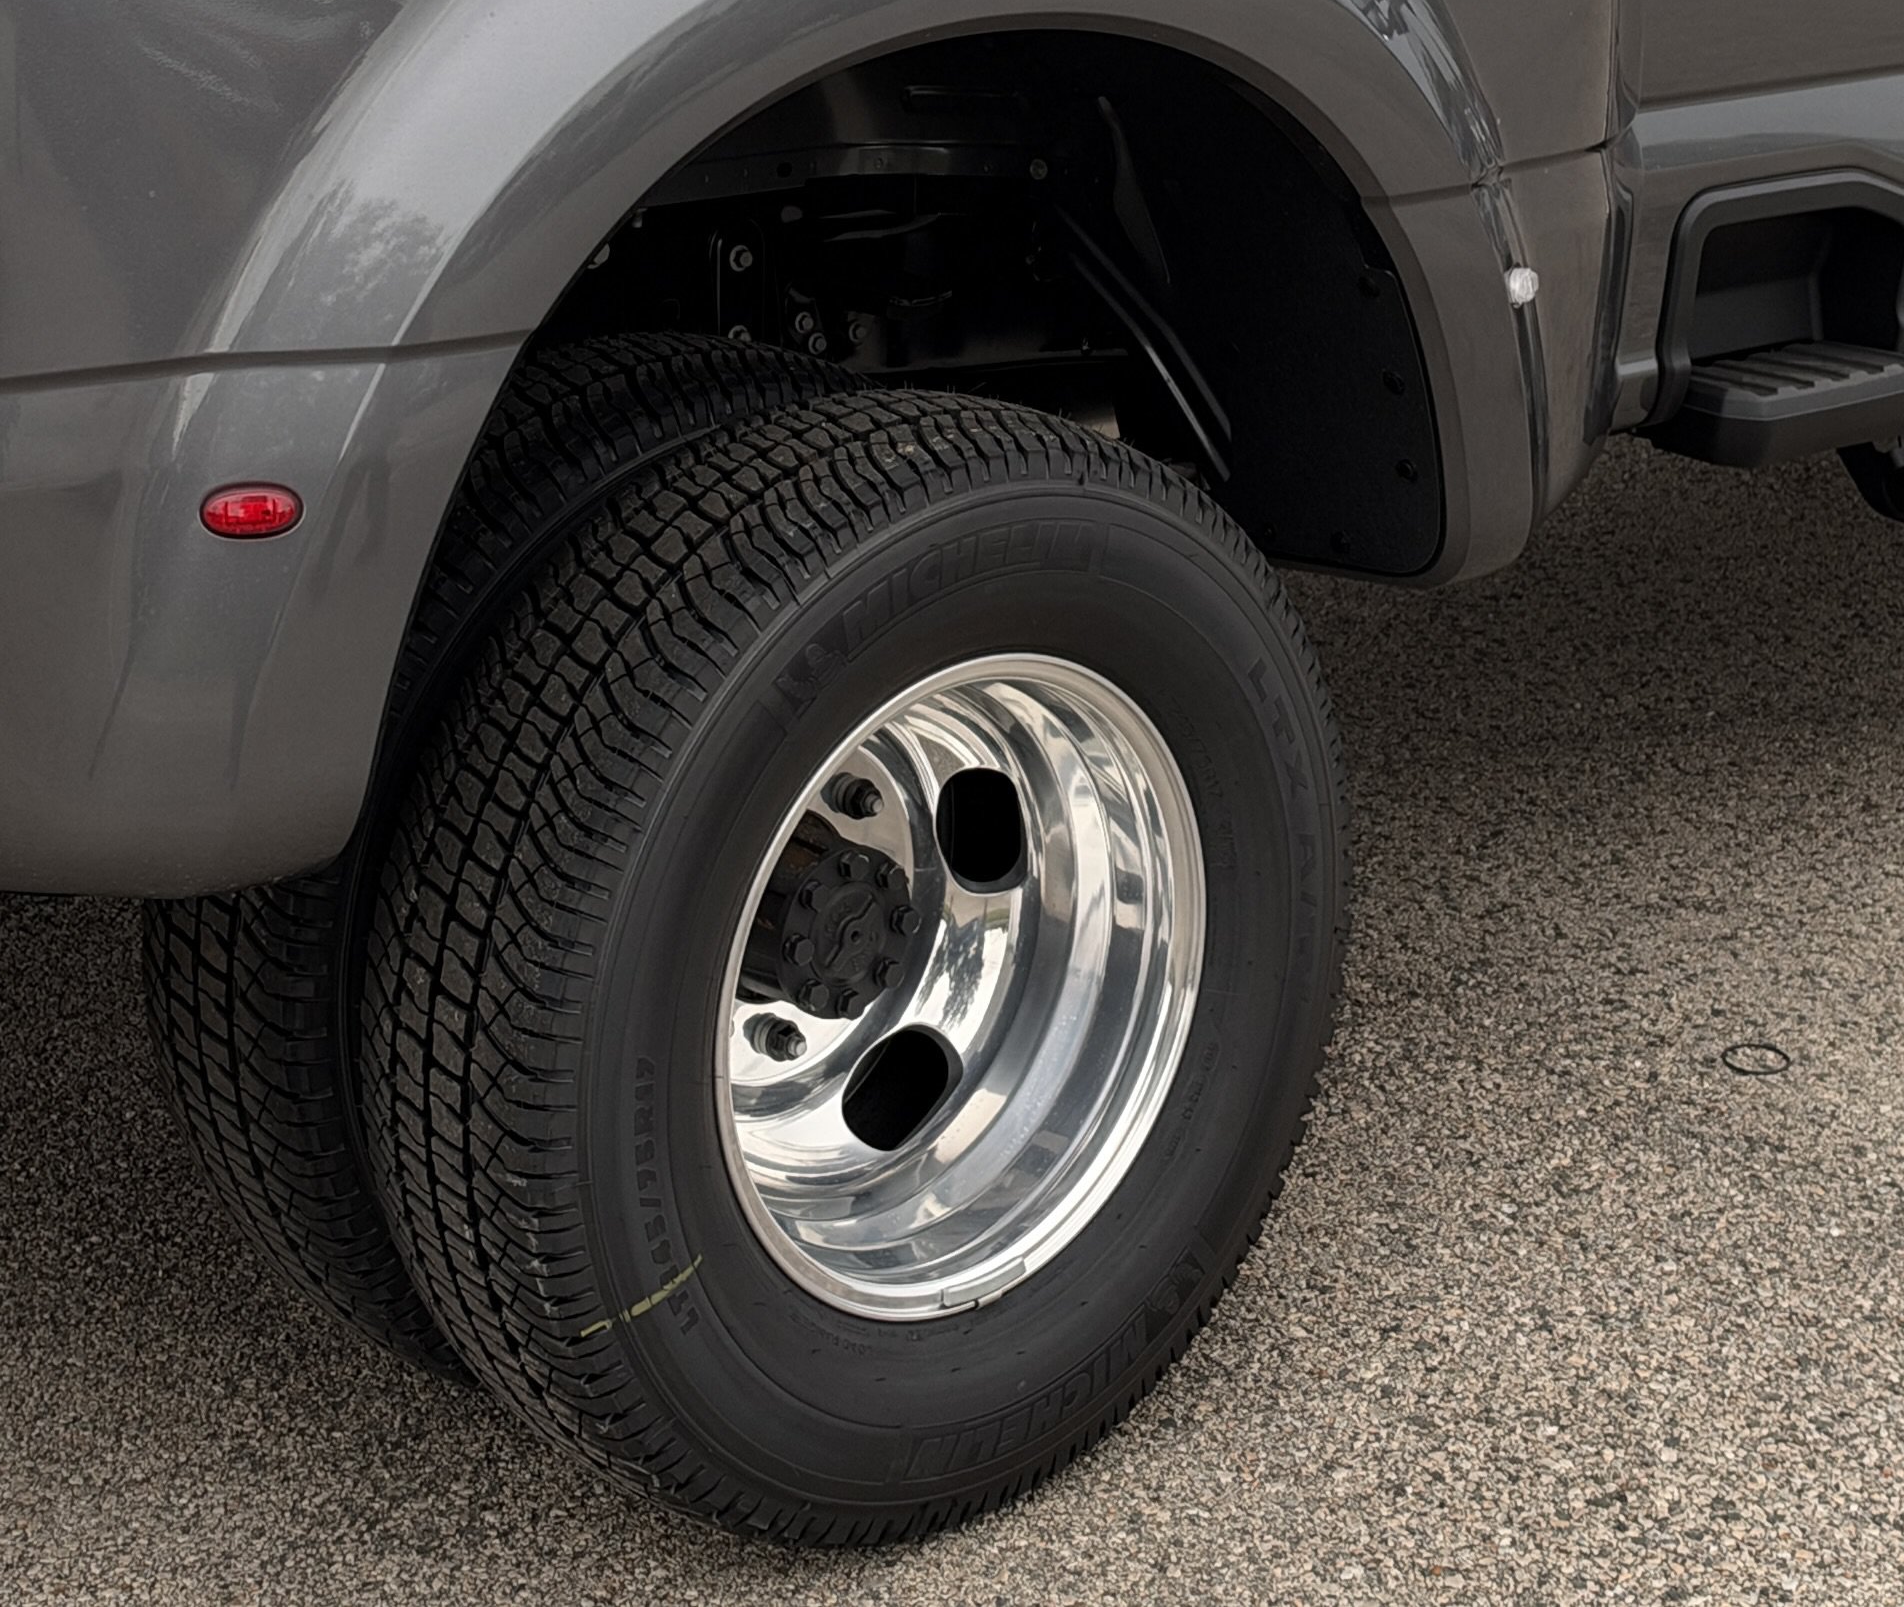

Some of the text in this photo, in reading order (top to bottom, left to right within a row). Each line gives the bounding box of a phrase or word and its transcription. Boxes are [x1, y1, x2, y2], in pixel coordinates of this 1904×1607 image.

[840, 520, 1094, 653] MICHELIN
[1246, 657, 1310, 801] LTX
[904, 1308, 1148, 1480] MICHELIN
